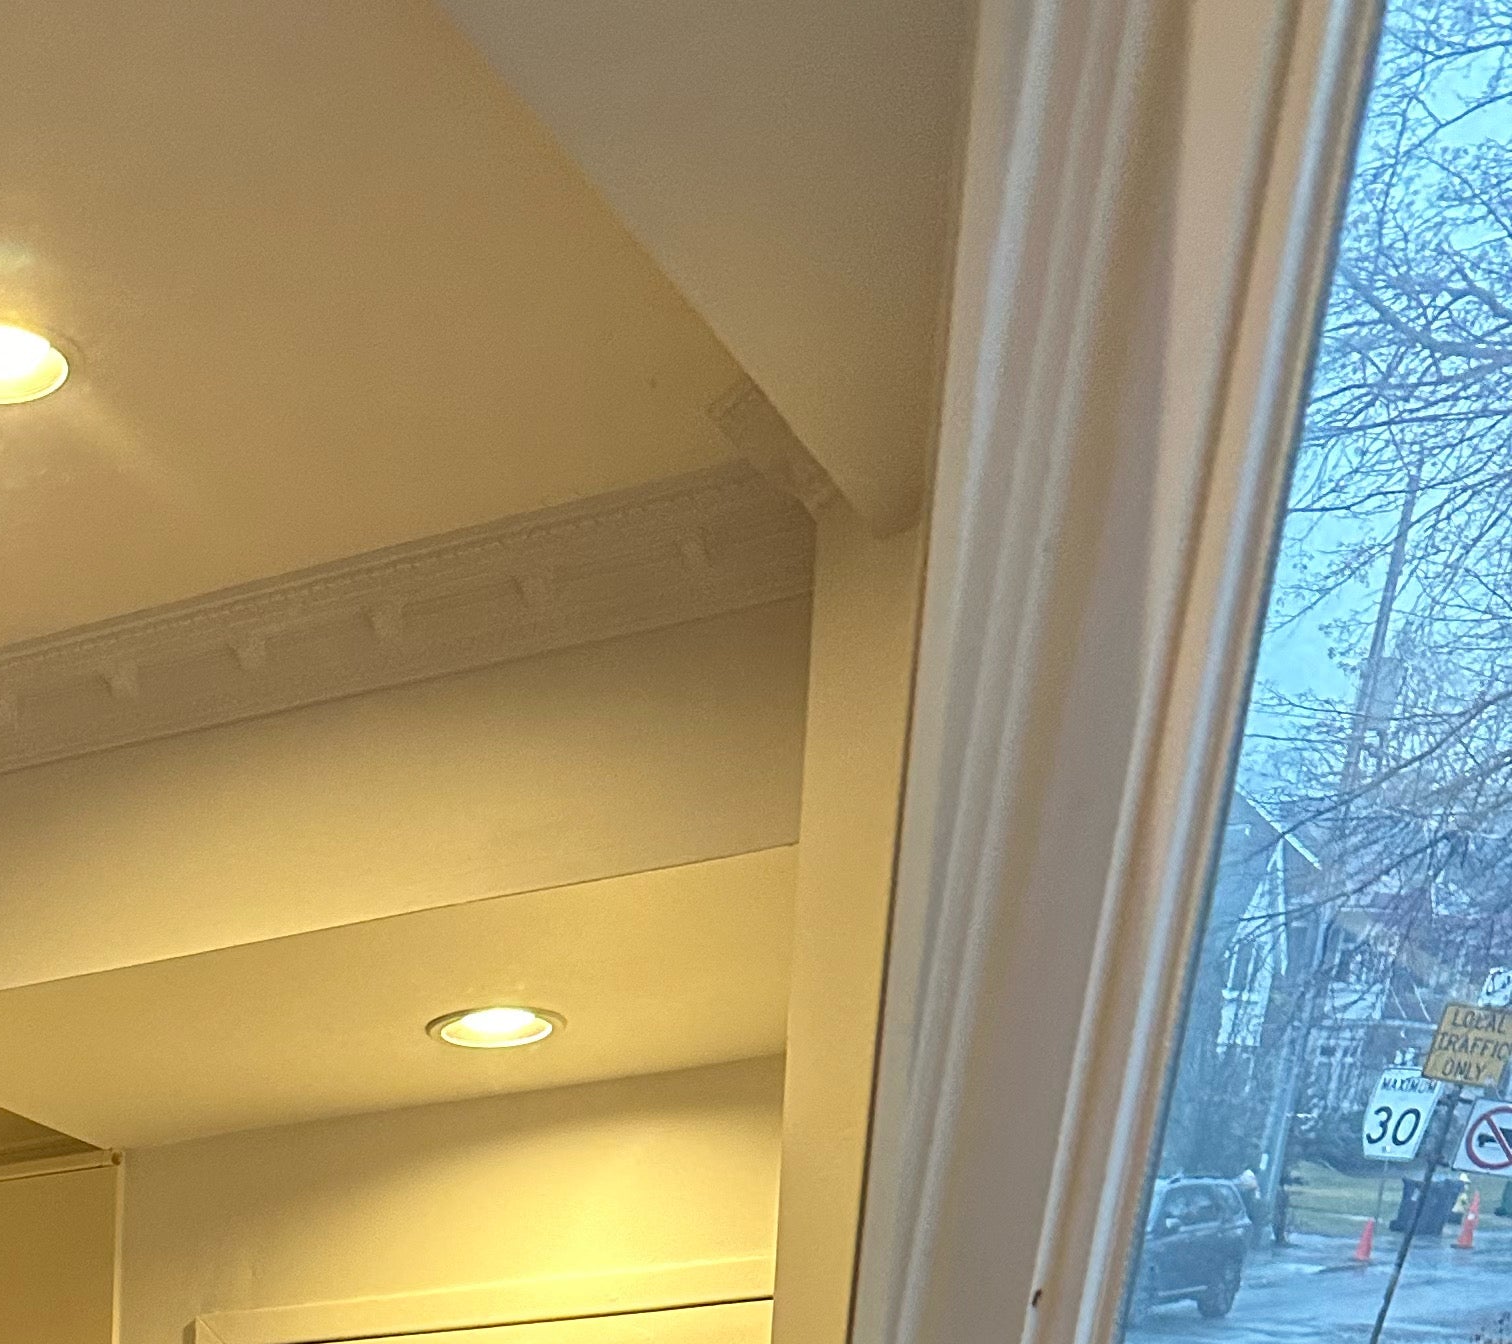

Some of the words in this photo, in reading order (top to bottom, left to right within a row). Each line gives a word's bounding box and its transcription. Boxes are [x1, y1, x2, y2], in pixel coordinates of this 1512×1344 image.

[1452, 1008, 1506, 1034] LOCAL
[1437, 1031, 1511, 1060] TRAFFIC
[1441, 1056, 1487, 1081] ONLY
[1381, 1076, 1437, 1094] MAXIMUM
[1366, 1106, 1421, 1146] 30
